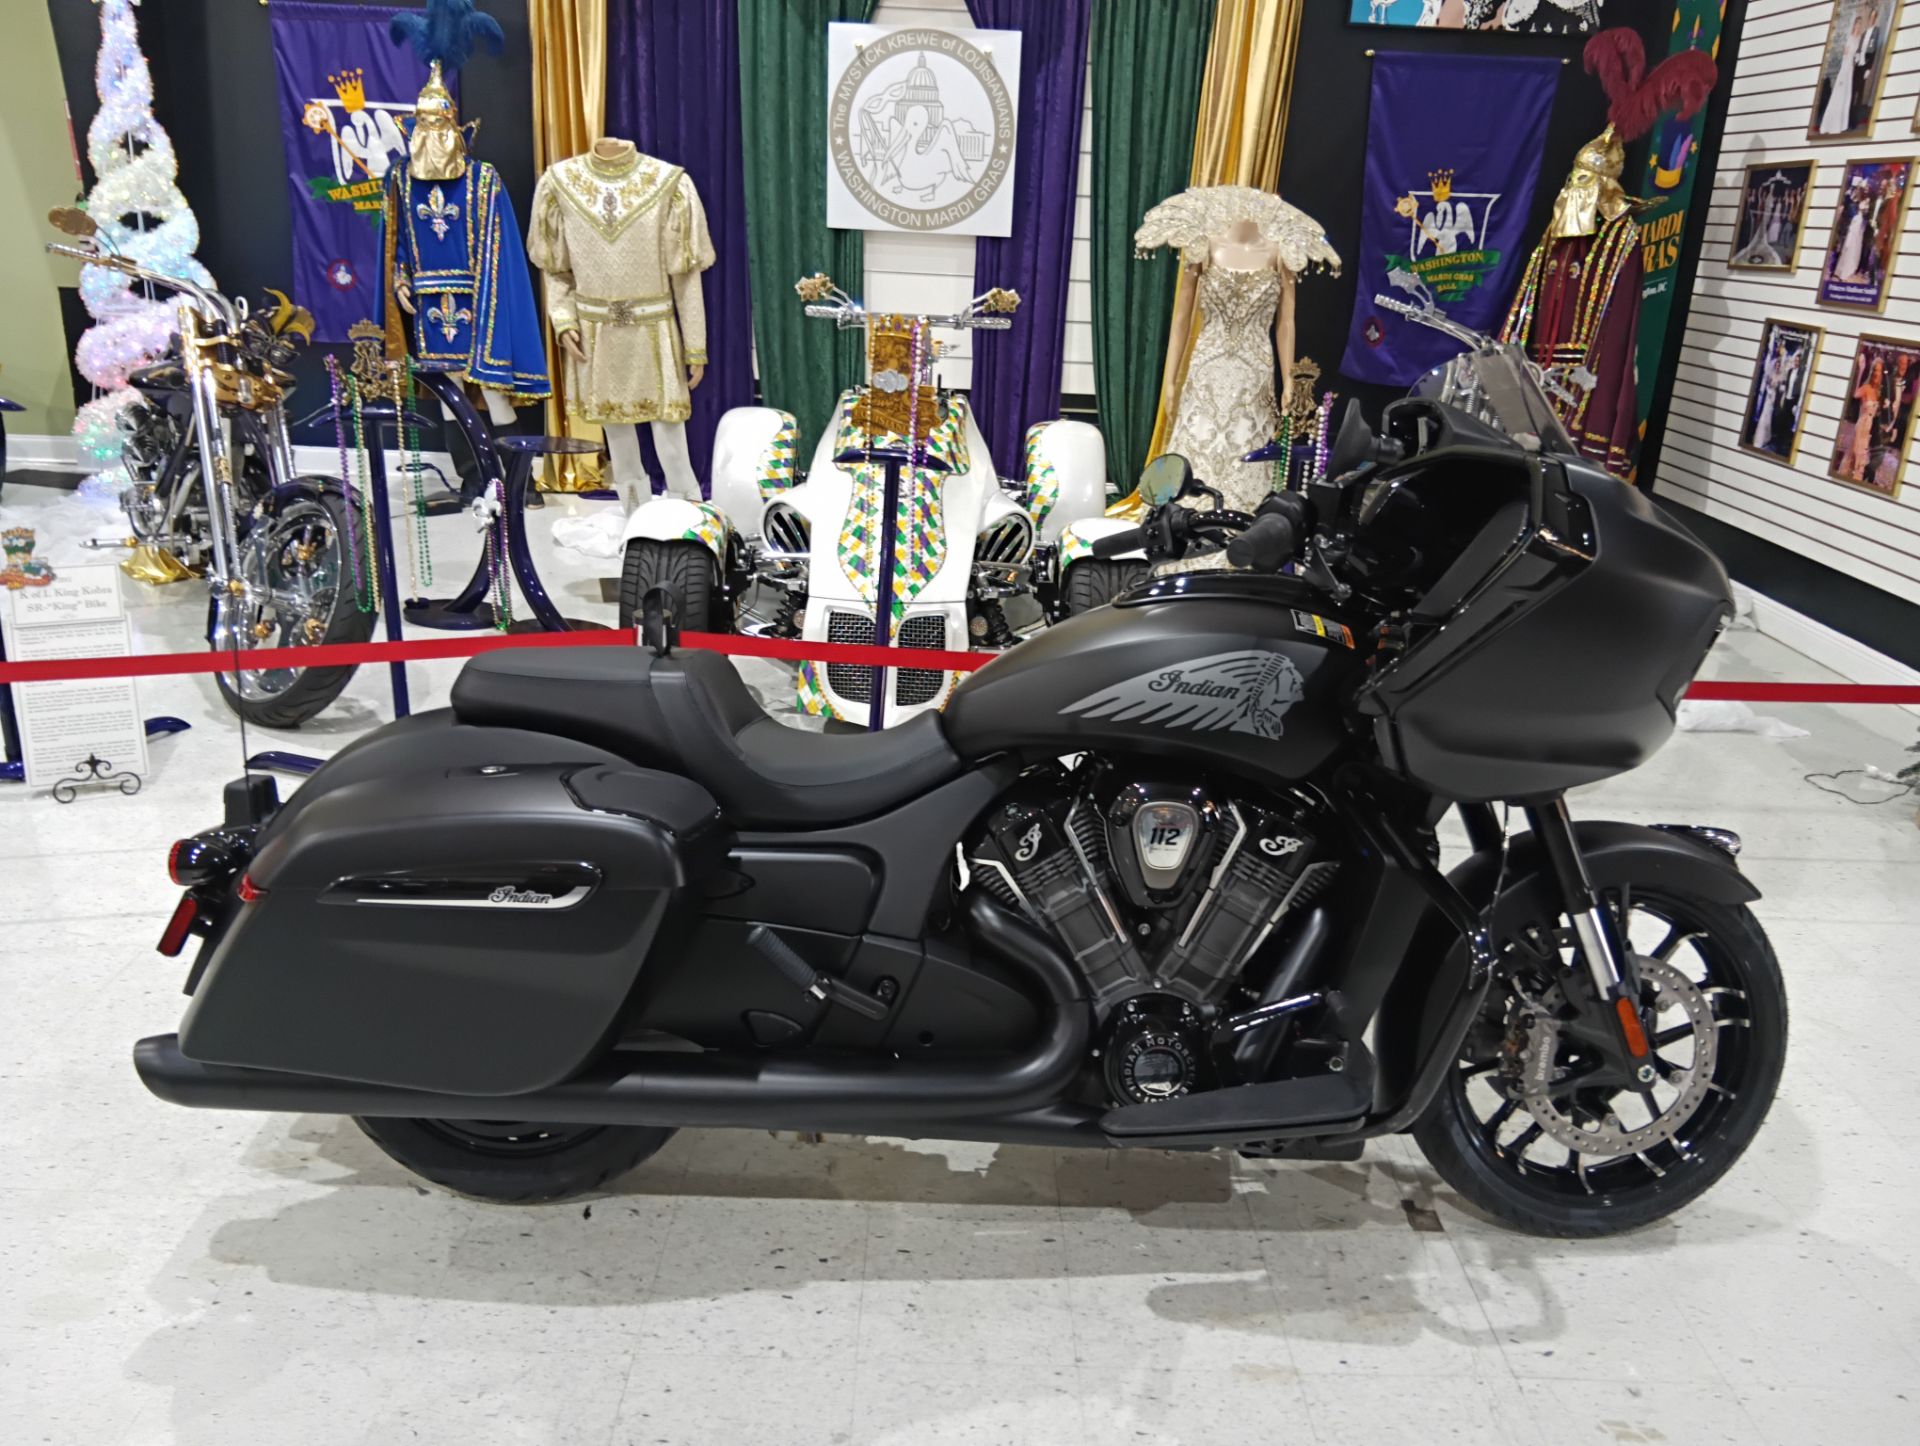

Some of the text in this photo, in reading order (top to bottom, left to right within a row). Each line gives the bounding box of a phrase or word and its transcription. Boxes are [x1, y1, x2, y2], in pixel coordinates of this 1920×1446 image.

[833, 32, 1011, 139] The MYSTICK KREWE of LOUISIANIANS
[328, 180, 383, 200] WASHI
[836, 152, 1006, 227] WASHINGTON MARDI GRAS
[1411, 252, 1484, 272] WASHINGTON
[1642, 236, 1680, 273] RAS
[55, 588, 79, 598] King
[85, 600, 107, 608] Bike
[1148, 670, 1240, 699] Indian
[1150, 828, 1181, 845] 112
[489, 885, 552, 904] Indian
[1534, 1036, 1551, 1080] brembo
